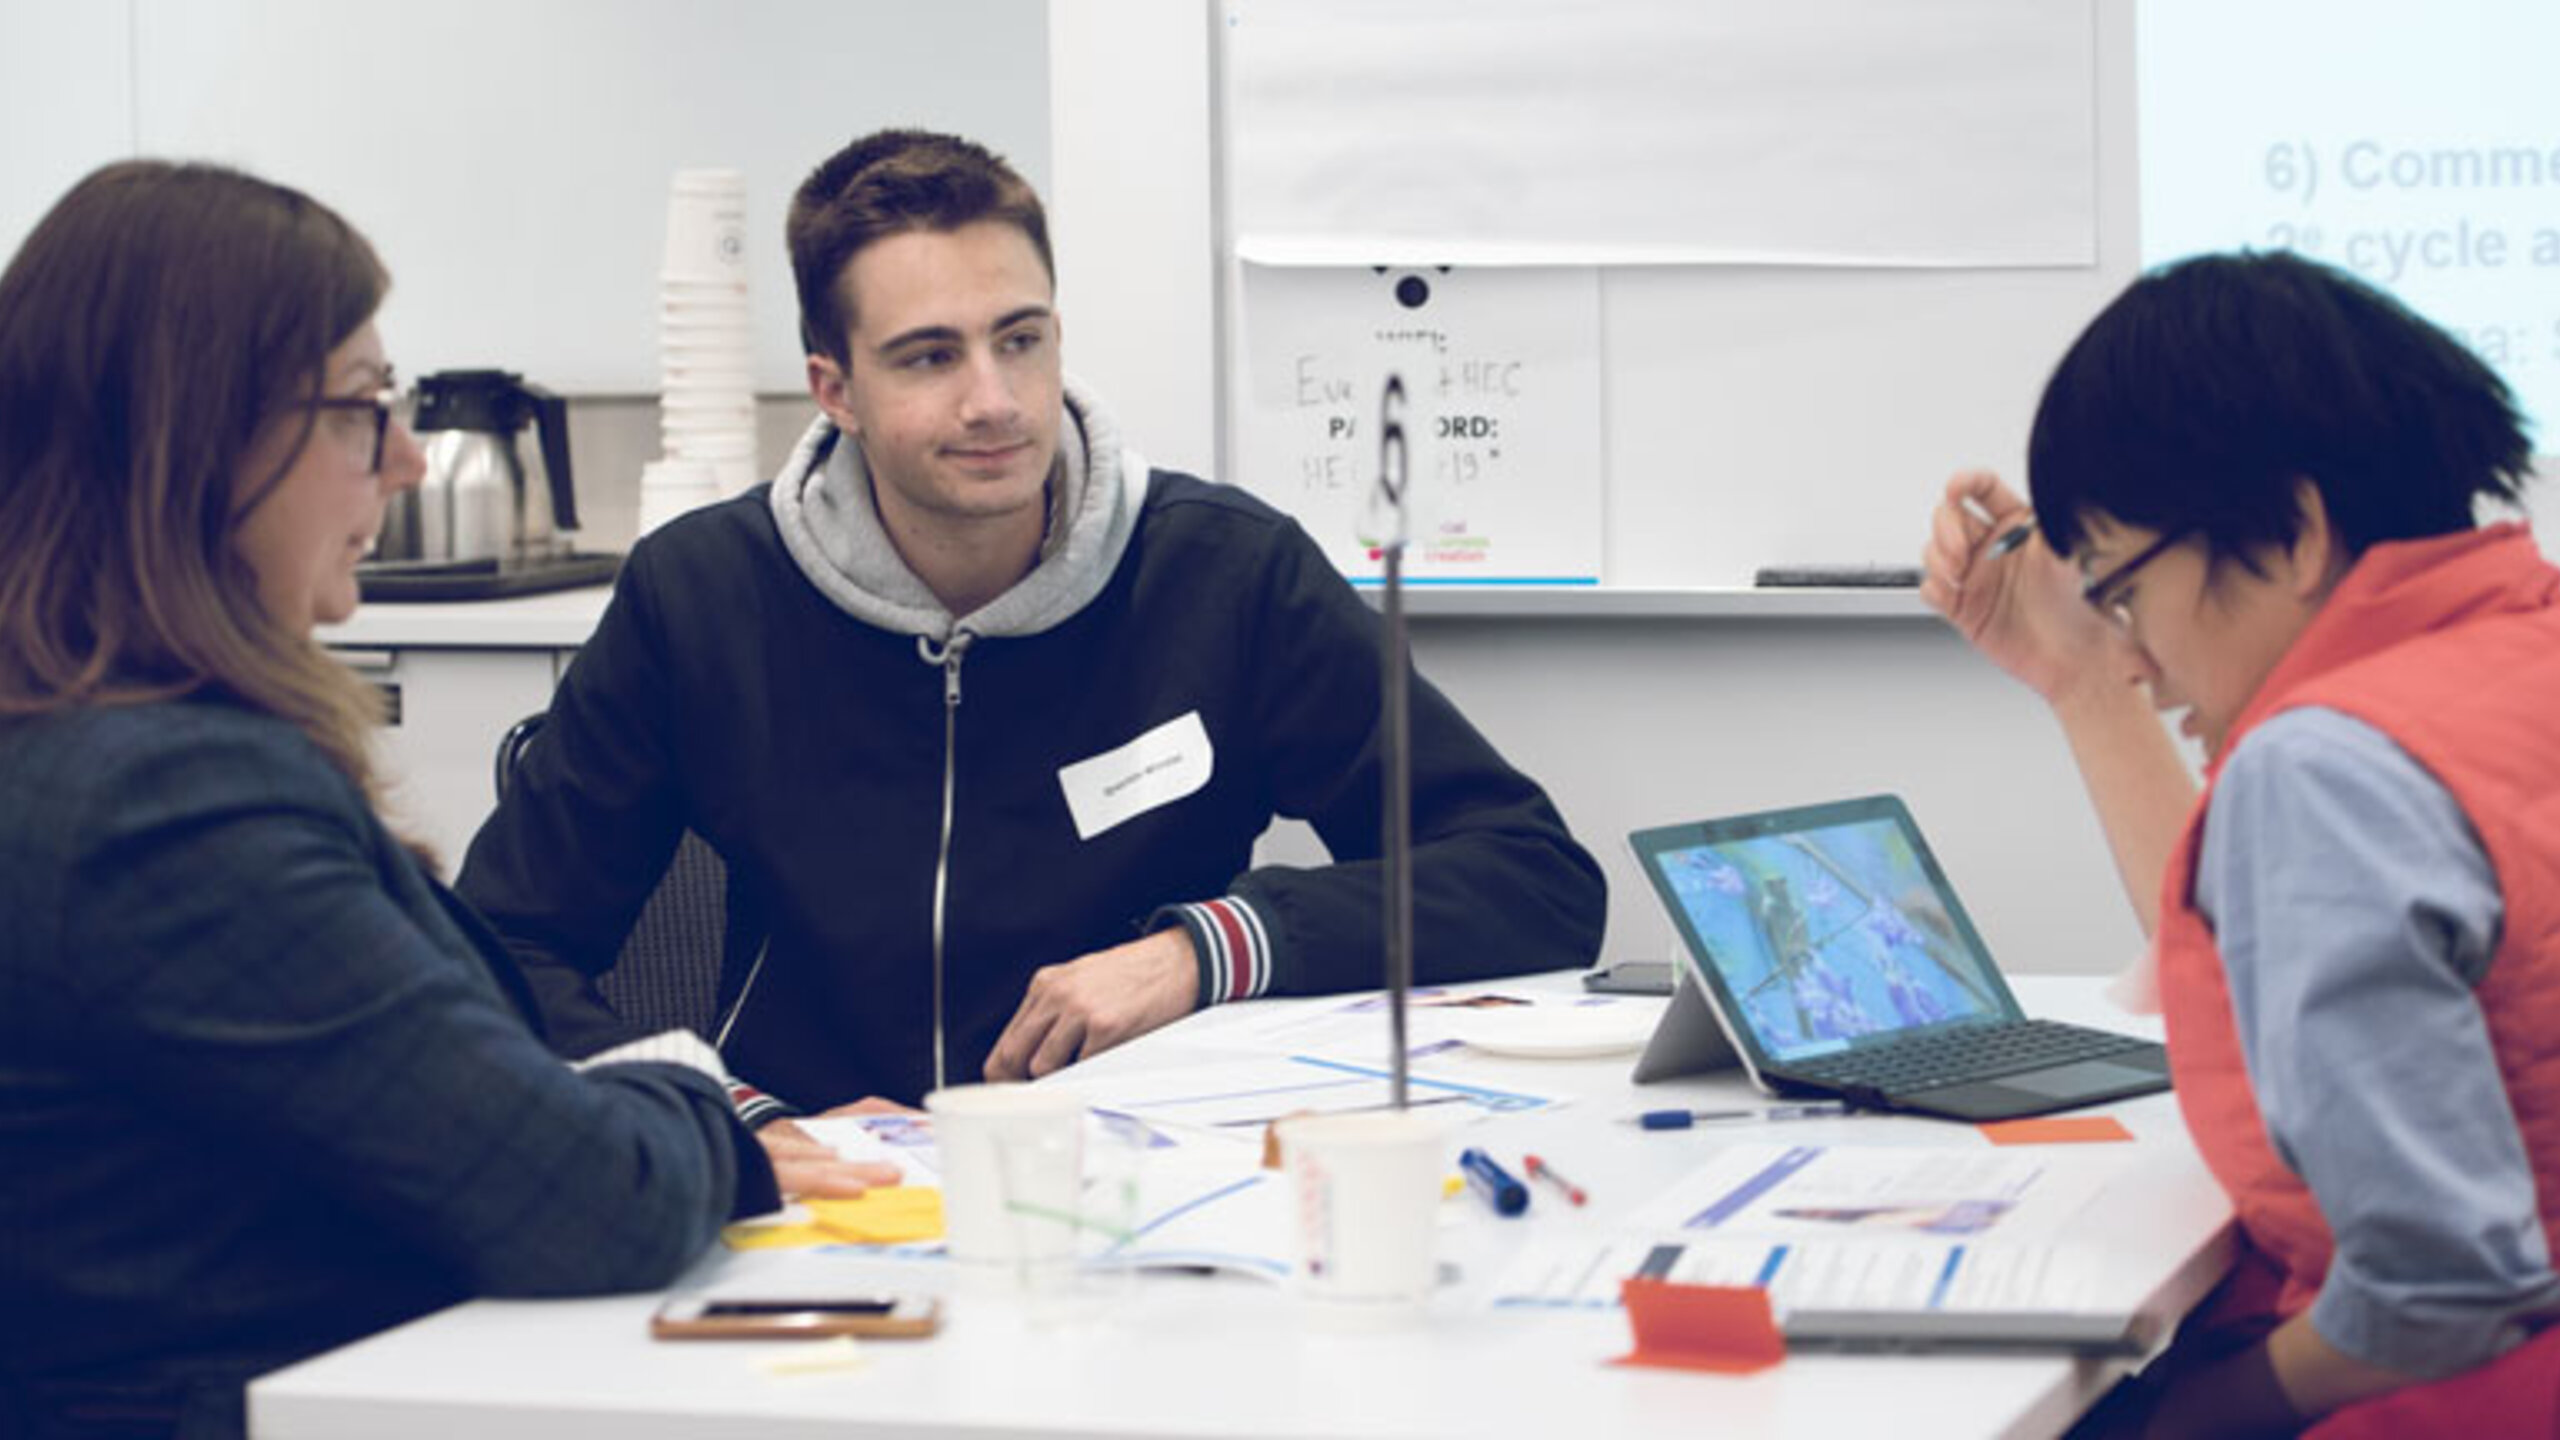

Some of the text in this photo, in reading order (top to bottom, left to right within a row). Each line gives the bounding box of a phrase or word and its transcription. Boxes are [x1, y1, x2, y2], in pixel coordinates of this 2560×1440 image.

[2263, 141, 2319, 206] 6)
[2345, 219, 2508, 283] cycle
[1380, 371, 1409, 501] 6
